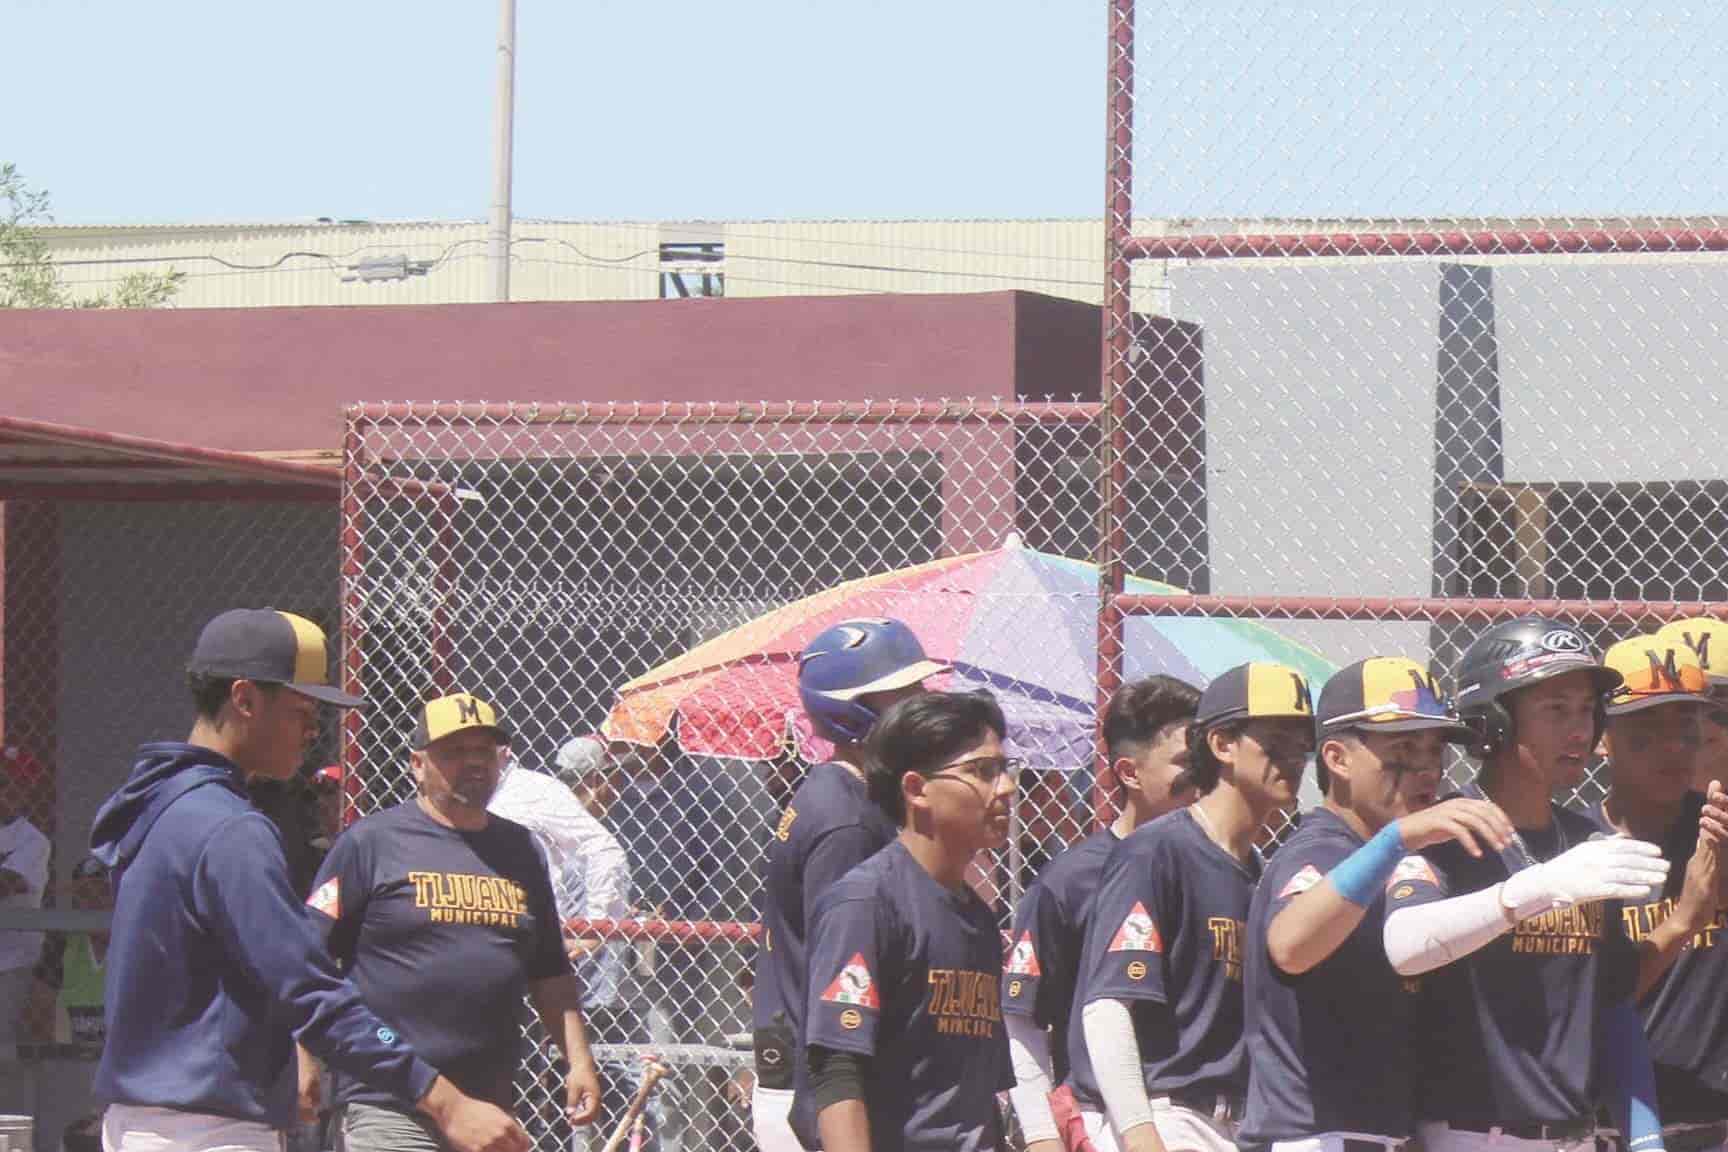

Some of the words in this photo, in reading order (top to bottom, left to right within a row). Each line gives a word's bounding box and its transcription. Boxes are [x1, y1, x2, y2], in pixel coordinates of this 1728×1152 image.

[455, 698, 483, 724] M
[430, 907, 518, 928] MUNICIPAL
[1512, 935, 1592, 954] MUNICIPAL
